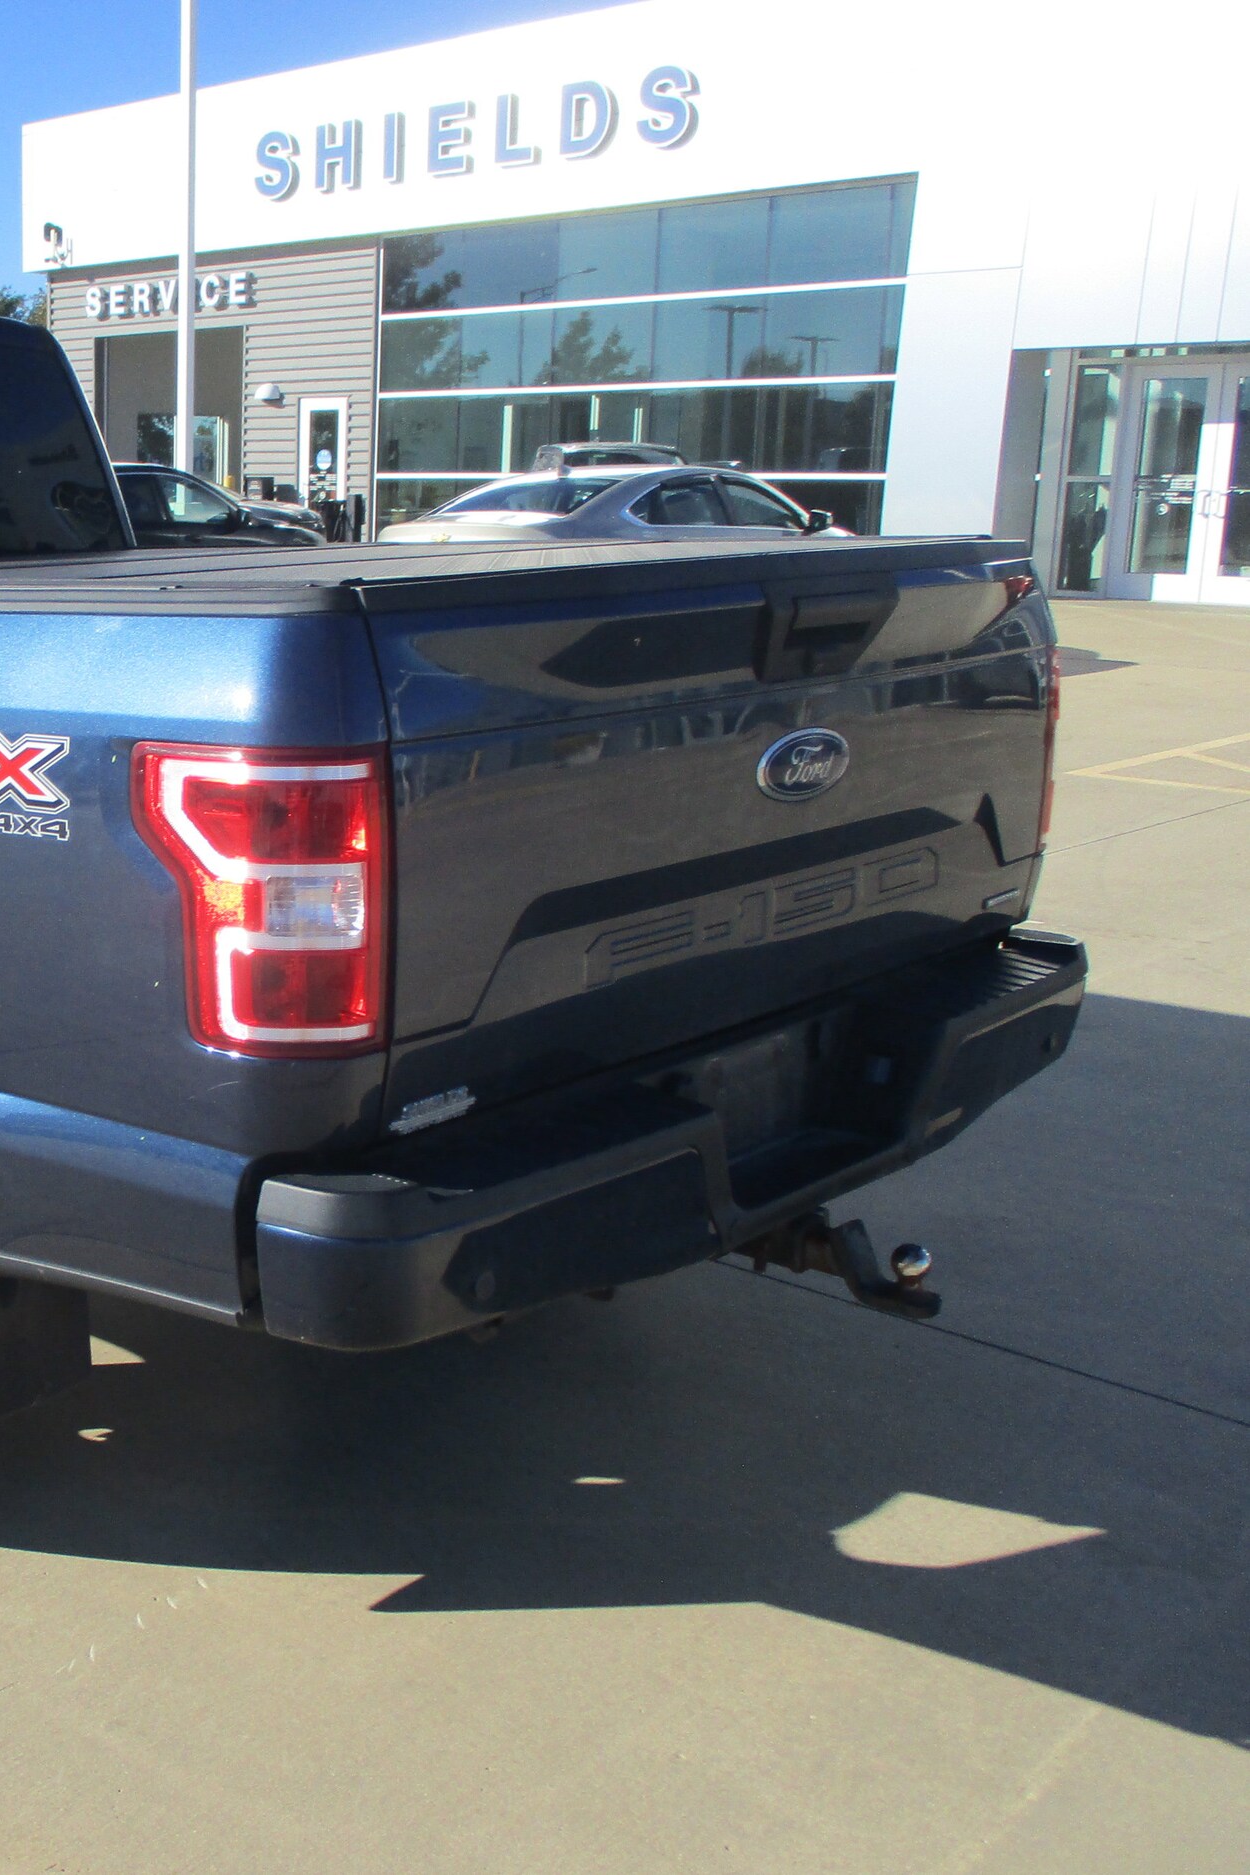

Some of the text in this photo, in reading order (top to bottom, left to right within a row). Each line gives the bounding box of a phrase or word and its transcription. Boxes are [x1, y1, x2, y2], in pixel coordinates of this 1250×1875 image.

[254, 64, 701, 202] SHIELDS
[84, 270, 253, 320] SERVCE
[784, 743, 837, 786] Ford
[583, 845, 940, 991] F-150
